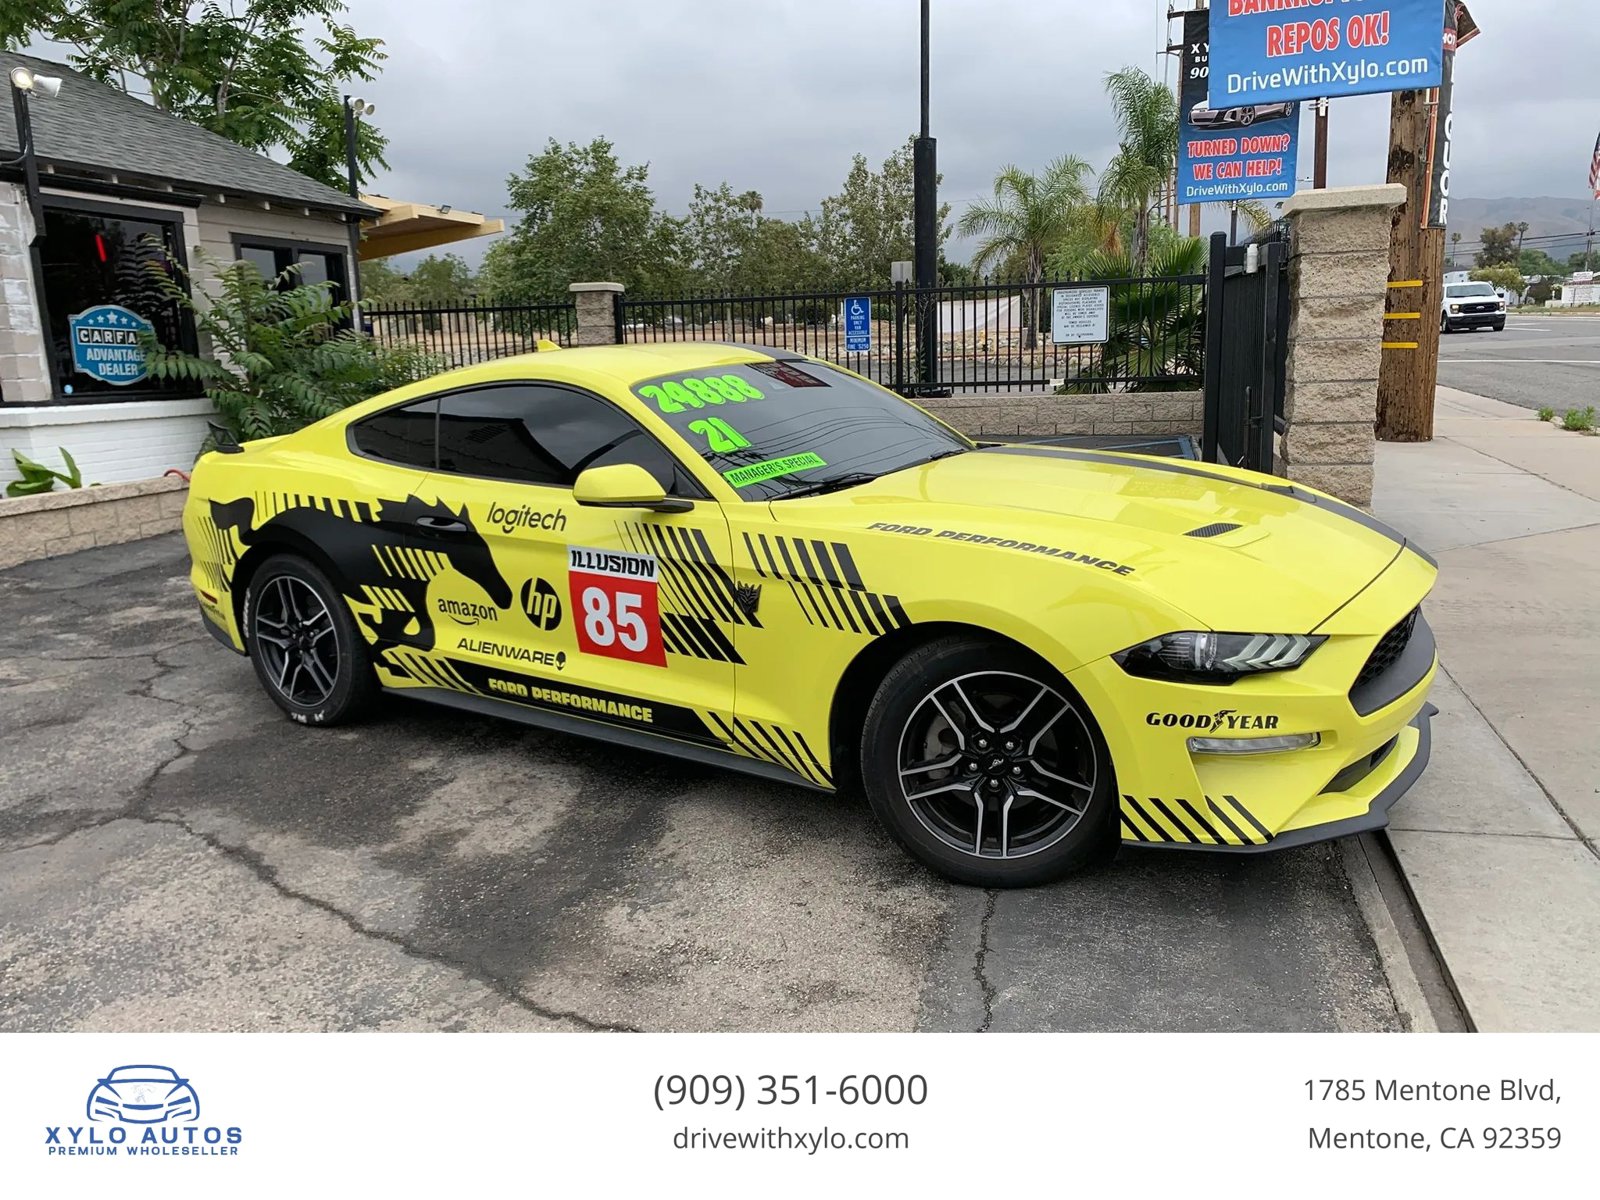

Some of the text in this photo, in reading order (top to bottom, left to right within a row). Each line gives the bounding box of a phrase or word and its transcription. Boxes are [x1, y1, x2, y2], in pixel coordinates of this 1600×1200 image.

[1267, 11, 1390, 57] REPOS OK!
[1228, 57, 1428, 94] DriveWithXylo.com
[1187, 134, 1290, 158] TURNED DOWN?
[1193, 158, 1282, 181] WE CAN HELP!
[1186, 182, 1288, 197] DriveWithXylo.com
[80, 331, 137, 344] CARFA
[86, 348, 146, 361] ADVANTAGE
[98, 363, 138, 375] DEALER
[638, 374, 765, 413] 24888
[688, 417, 752, 453] 21
[729, 454, 819, 483] MANAGER'S SPECIAL
[486, 502, 567, 533] logitech
[571, 550, 655, 577] ILLUSION
[866, 522, 1136, 576] FORD PERFORMANCE
[438, 598, 498, 622] amazon
[525, 577, 558, 631] hp
[582, 586, 649, 653] 85
[457, 638, 555, 666] ALIENWARE
[488, 678, 653, 723] FORD PERFORMANCE
